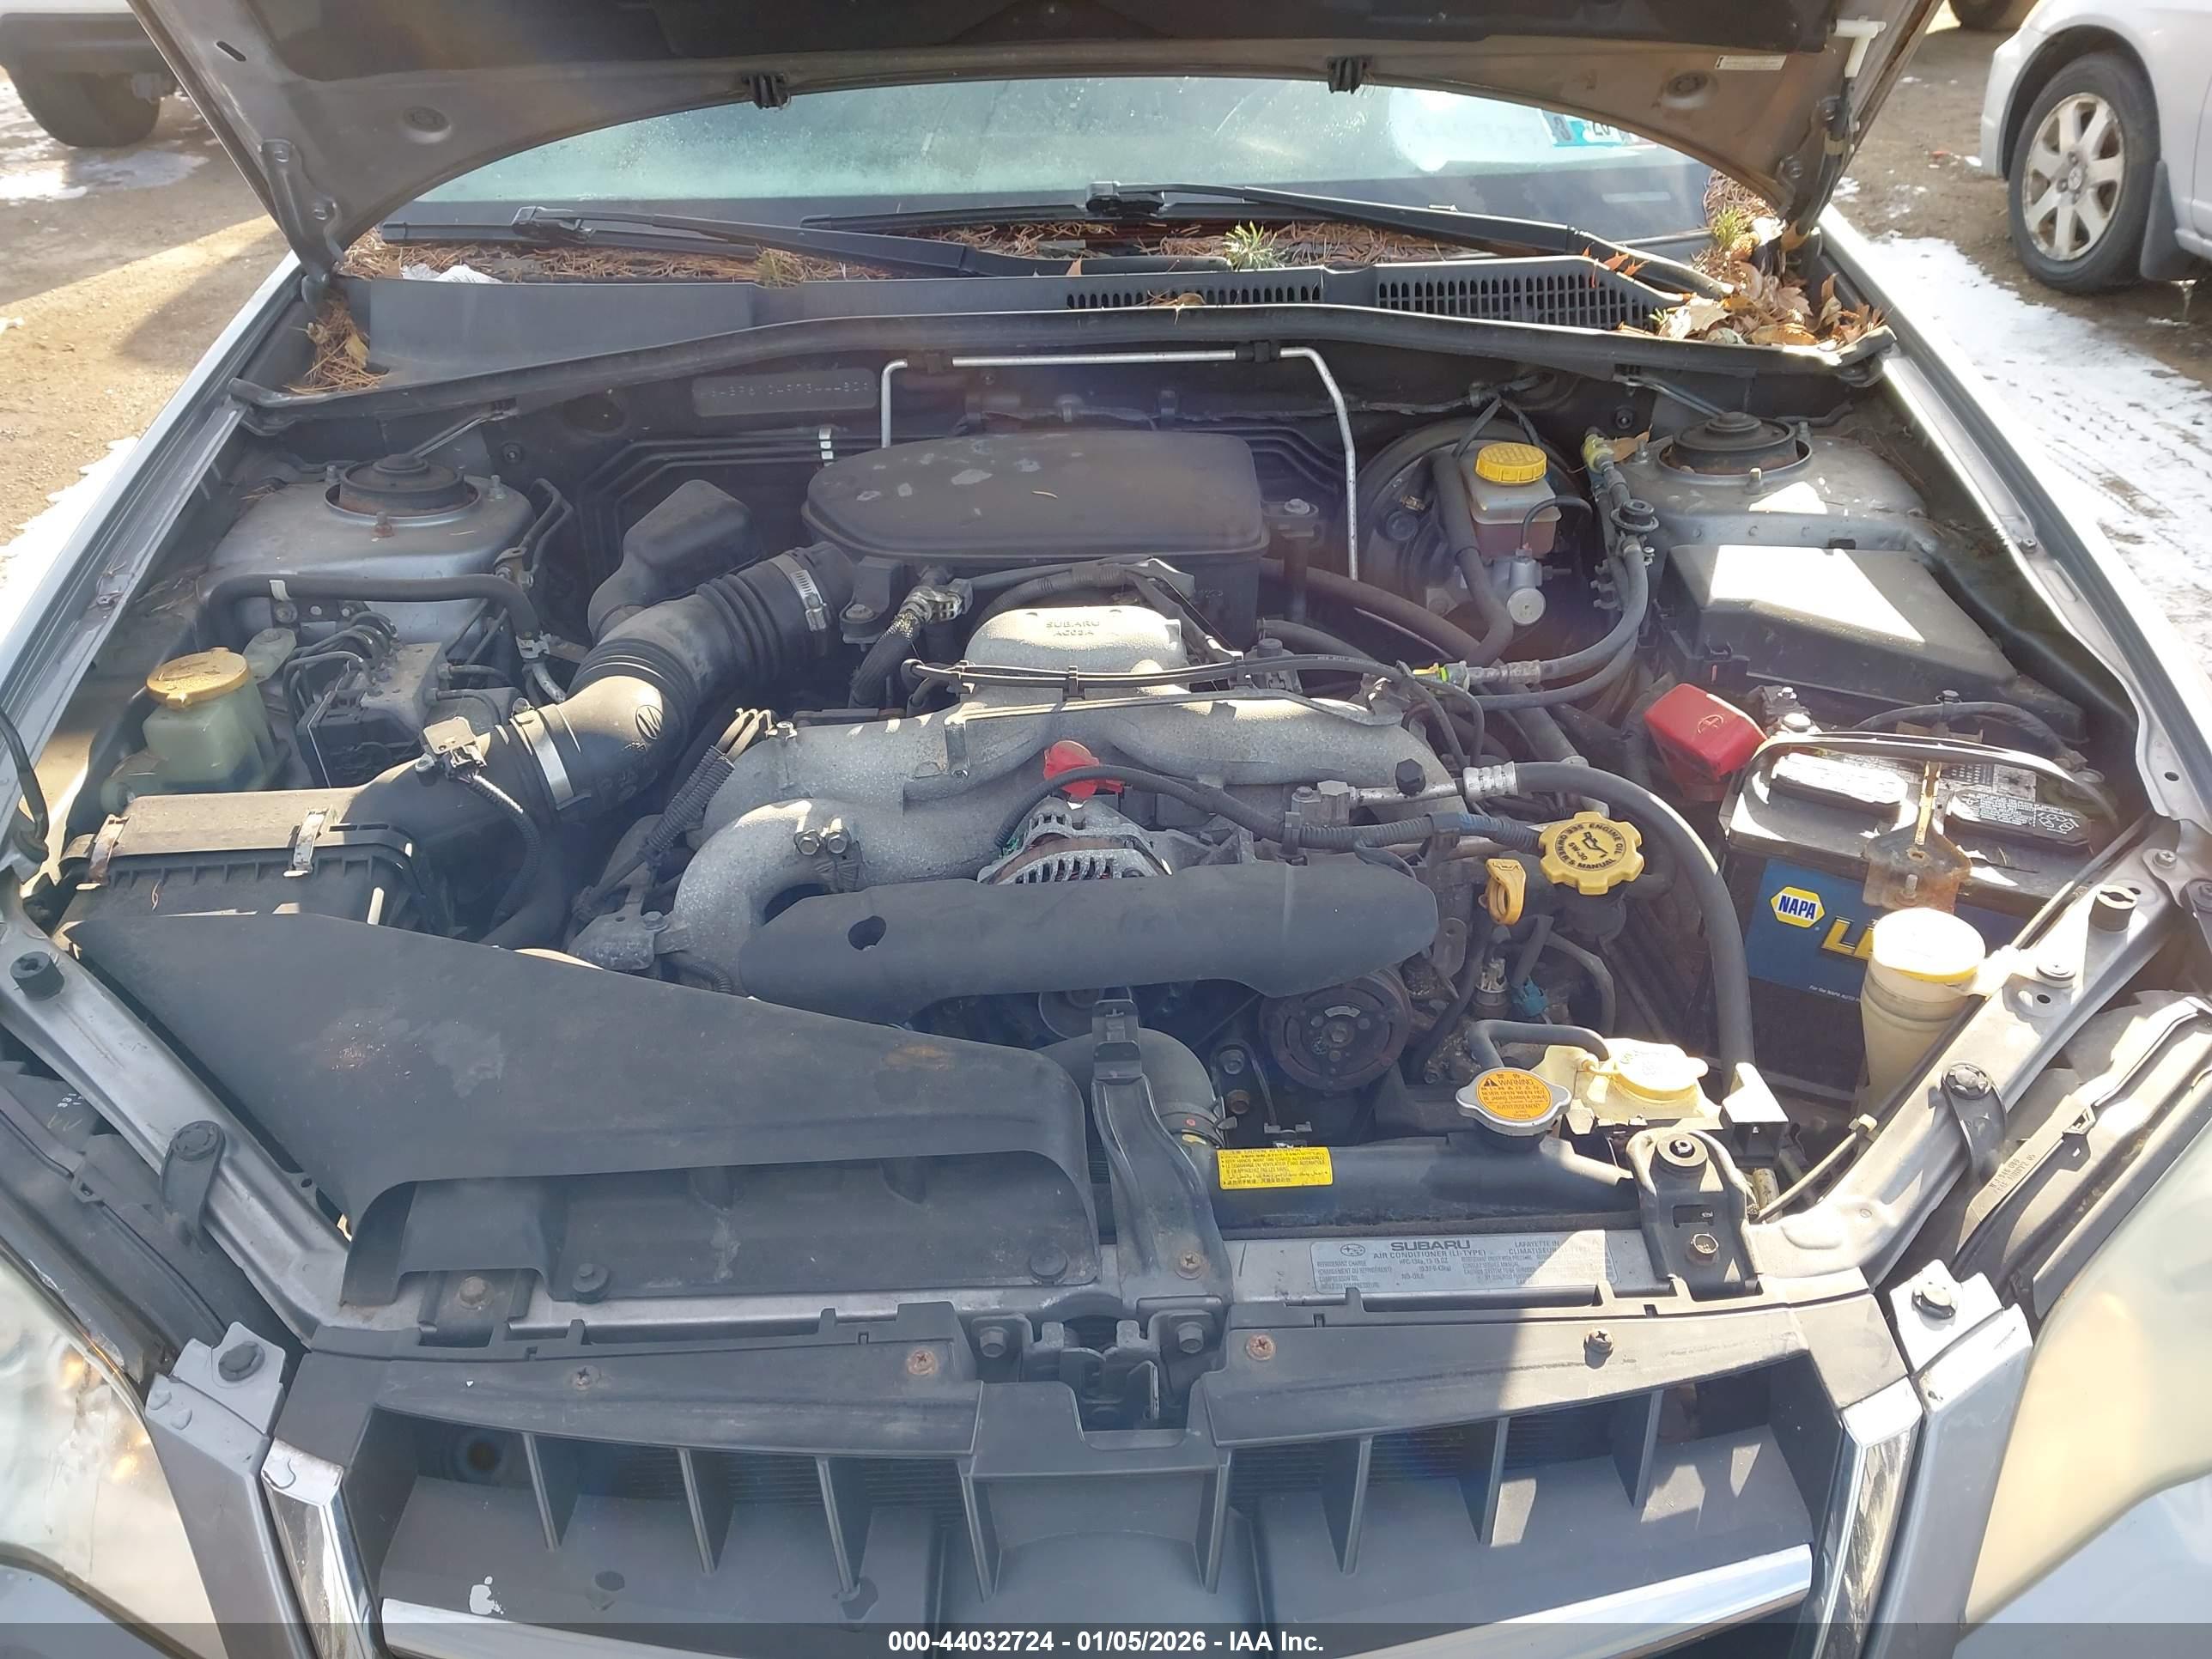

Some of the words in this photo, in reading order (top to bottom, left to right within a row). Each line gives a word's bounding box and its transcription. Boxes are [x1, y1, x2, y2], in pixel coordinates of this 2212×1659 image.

[1566, 823, 1584, 836] SEE
[1577, 858, 1616, 870] MANUAL
[1589, 823, 1621, 842] ENGINE
[1614, 842, 1624, 854] OIL
[1567, 842, 1588, 860] 5W-30
[1778, 895, 1817, 921] NAPA
[1389, 1250, 1449, 1259] CONDITIONER
[1449, 1249, 1486, 1257] (LI-TYPE)
[1390, 1239, 1471, 1251] SUBARU
